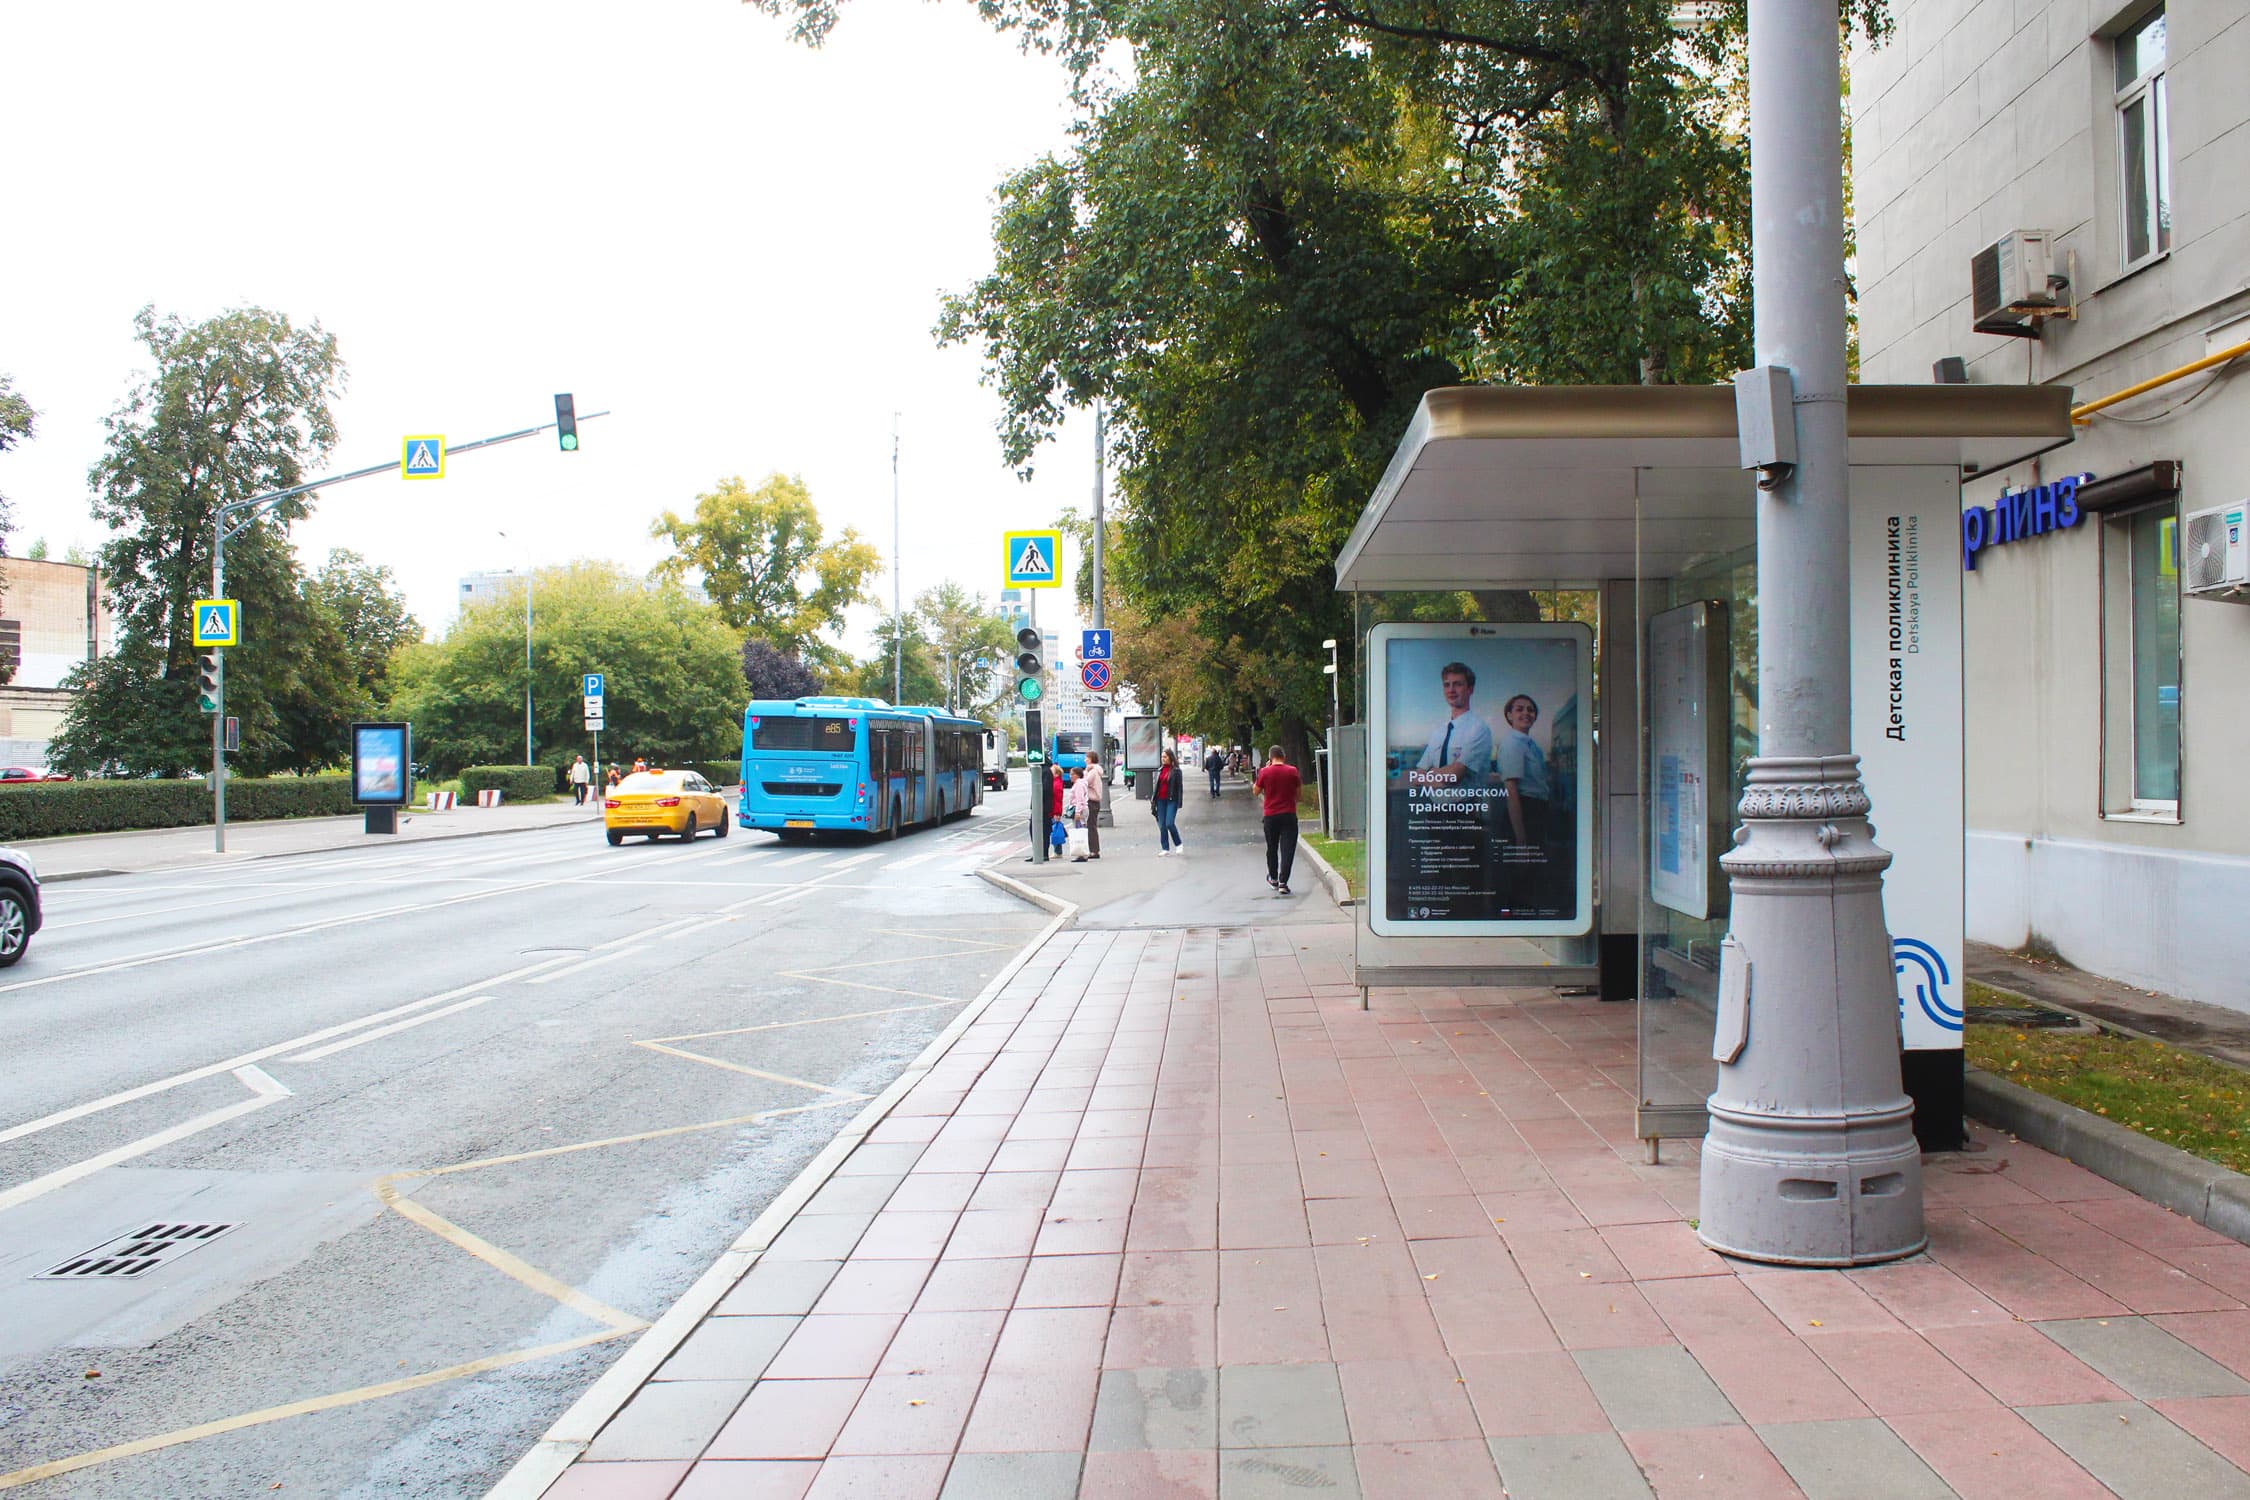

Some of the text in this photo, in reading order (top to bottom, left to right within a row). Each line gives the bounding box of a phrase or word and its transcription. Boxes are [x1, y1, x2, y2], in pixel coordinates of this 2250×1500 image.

[1907, 515, 1921, 654] Detskaya Poliklinika
[1886, 516, 1905, 741] Детская поликлиника
[588, 676, 599, 695] P
[1409, 770, 1457, 783] Работа
[1409, 785, 1509, 797] в Московском
[1408, 803, 1489, 815] транспорте
